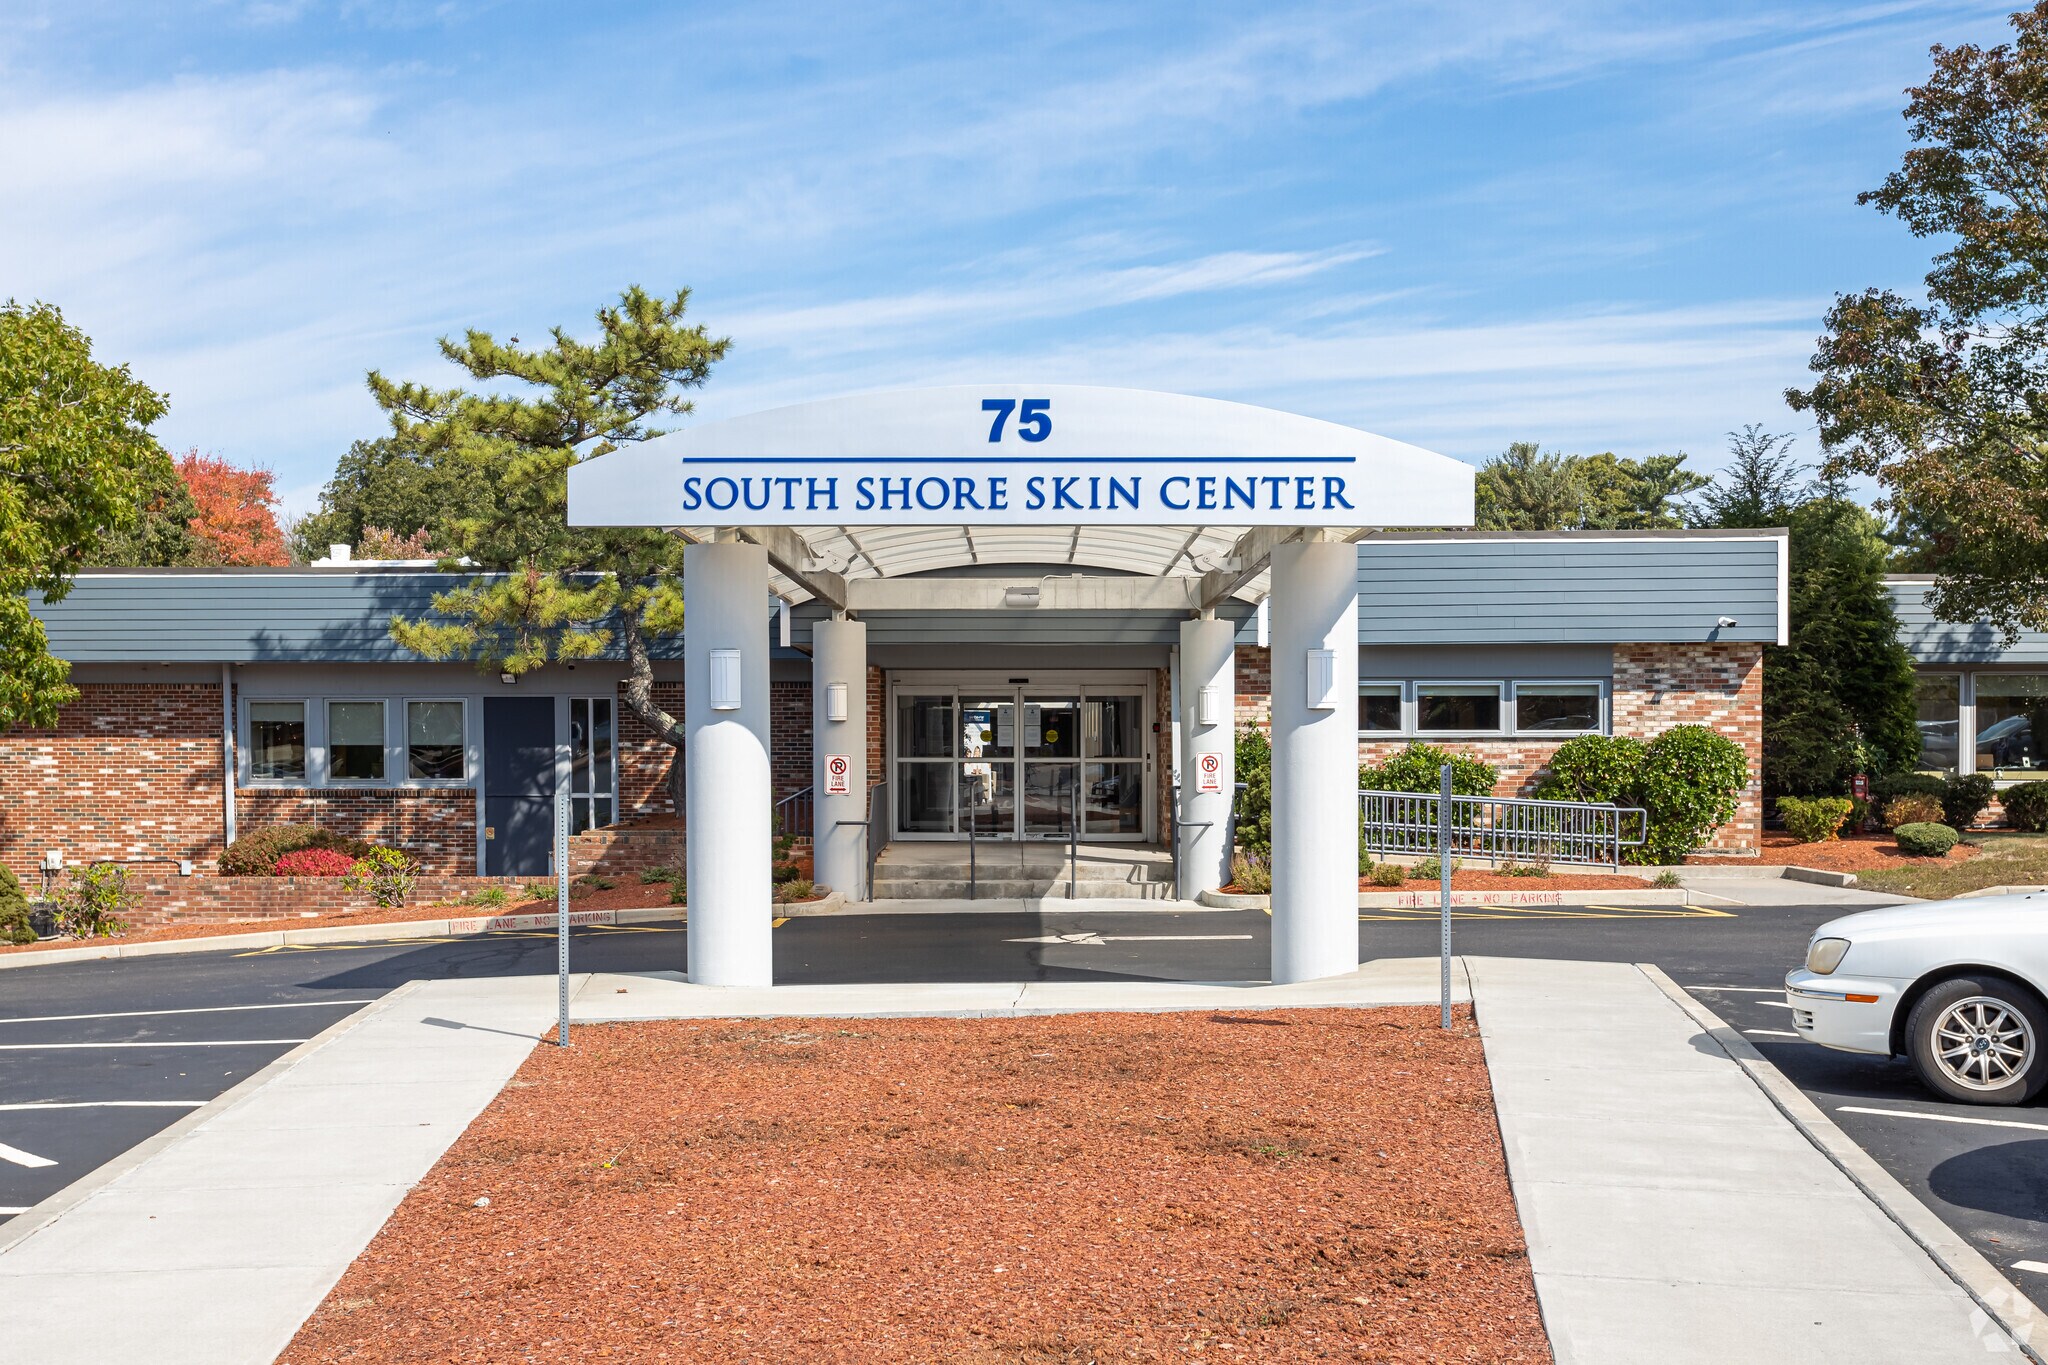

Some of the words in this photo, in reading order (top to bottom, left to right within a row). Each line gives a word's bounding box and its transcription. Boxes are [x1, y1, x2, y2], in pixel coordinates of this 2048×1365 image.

[981, 398, 1053, 443] 75
[682, 476, 839, 511] SOUTH
[855, 476, 1009, 511] SHORE
[1025, 475, 1142, 511] SKIN
[1159, 475, 1355, 511] CENTER
[1398, 895, 1424, 906] FIRE
[1432, 894, 1465, 906] LNE
[1484, 893, 1500, 904] NO
[1511, 893, 1563, 904] PARKING
[451, 920, 477, 932] FIRE
[486, 917, 517, 931] LANE
[534, 915, 551, 927] NO
[568, 912, 611, 925] ARKING
